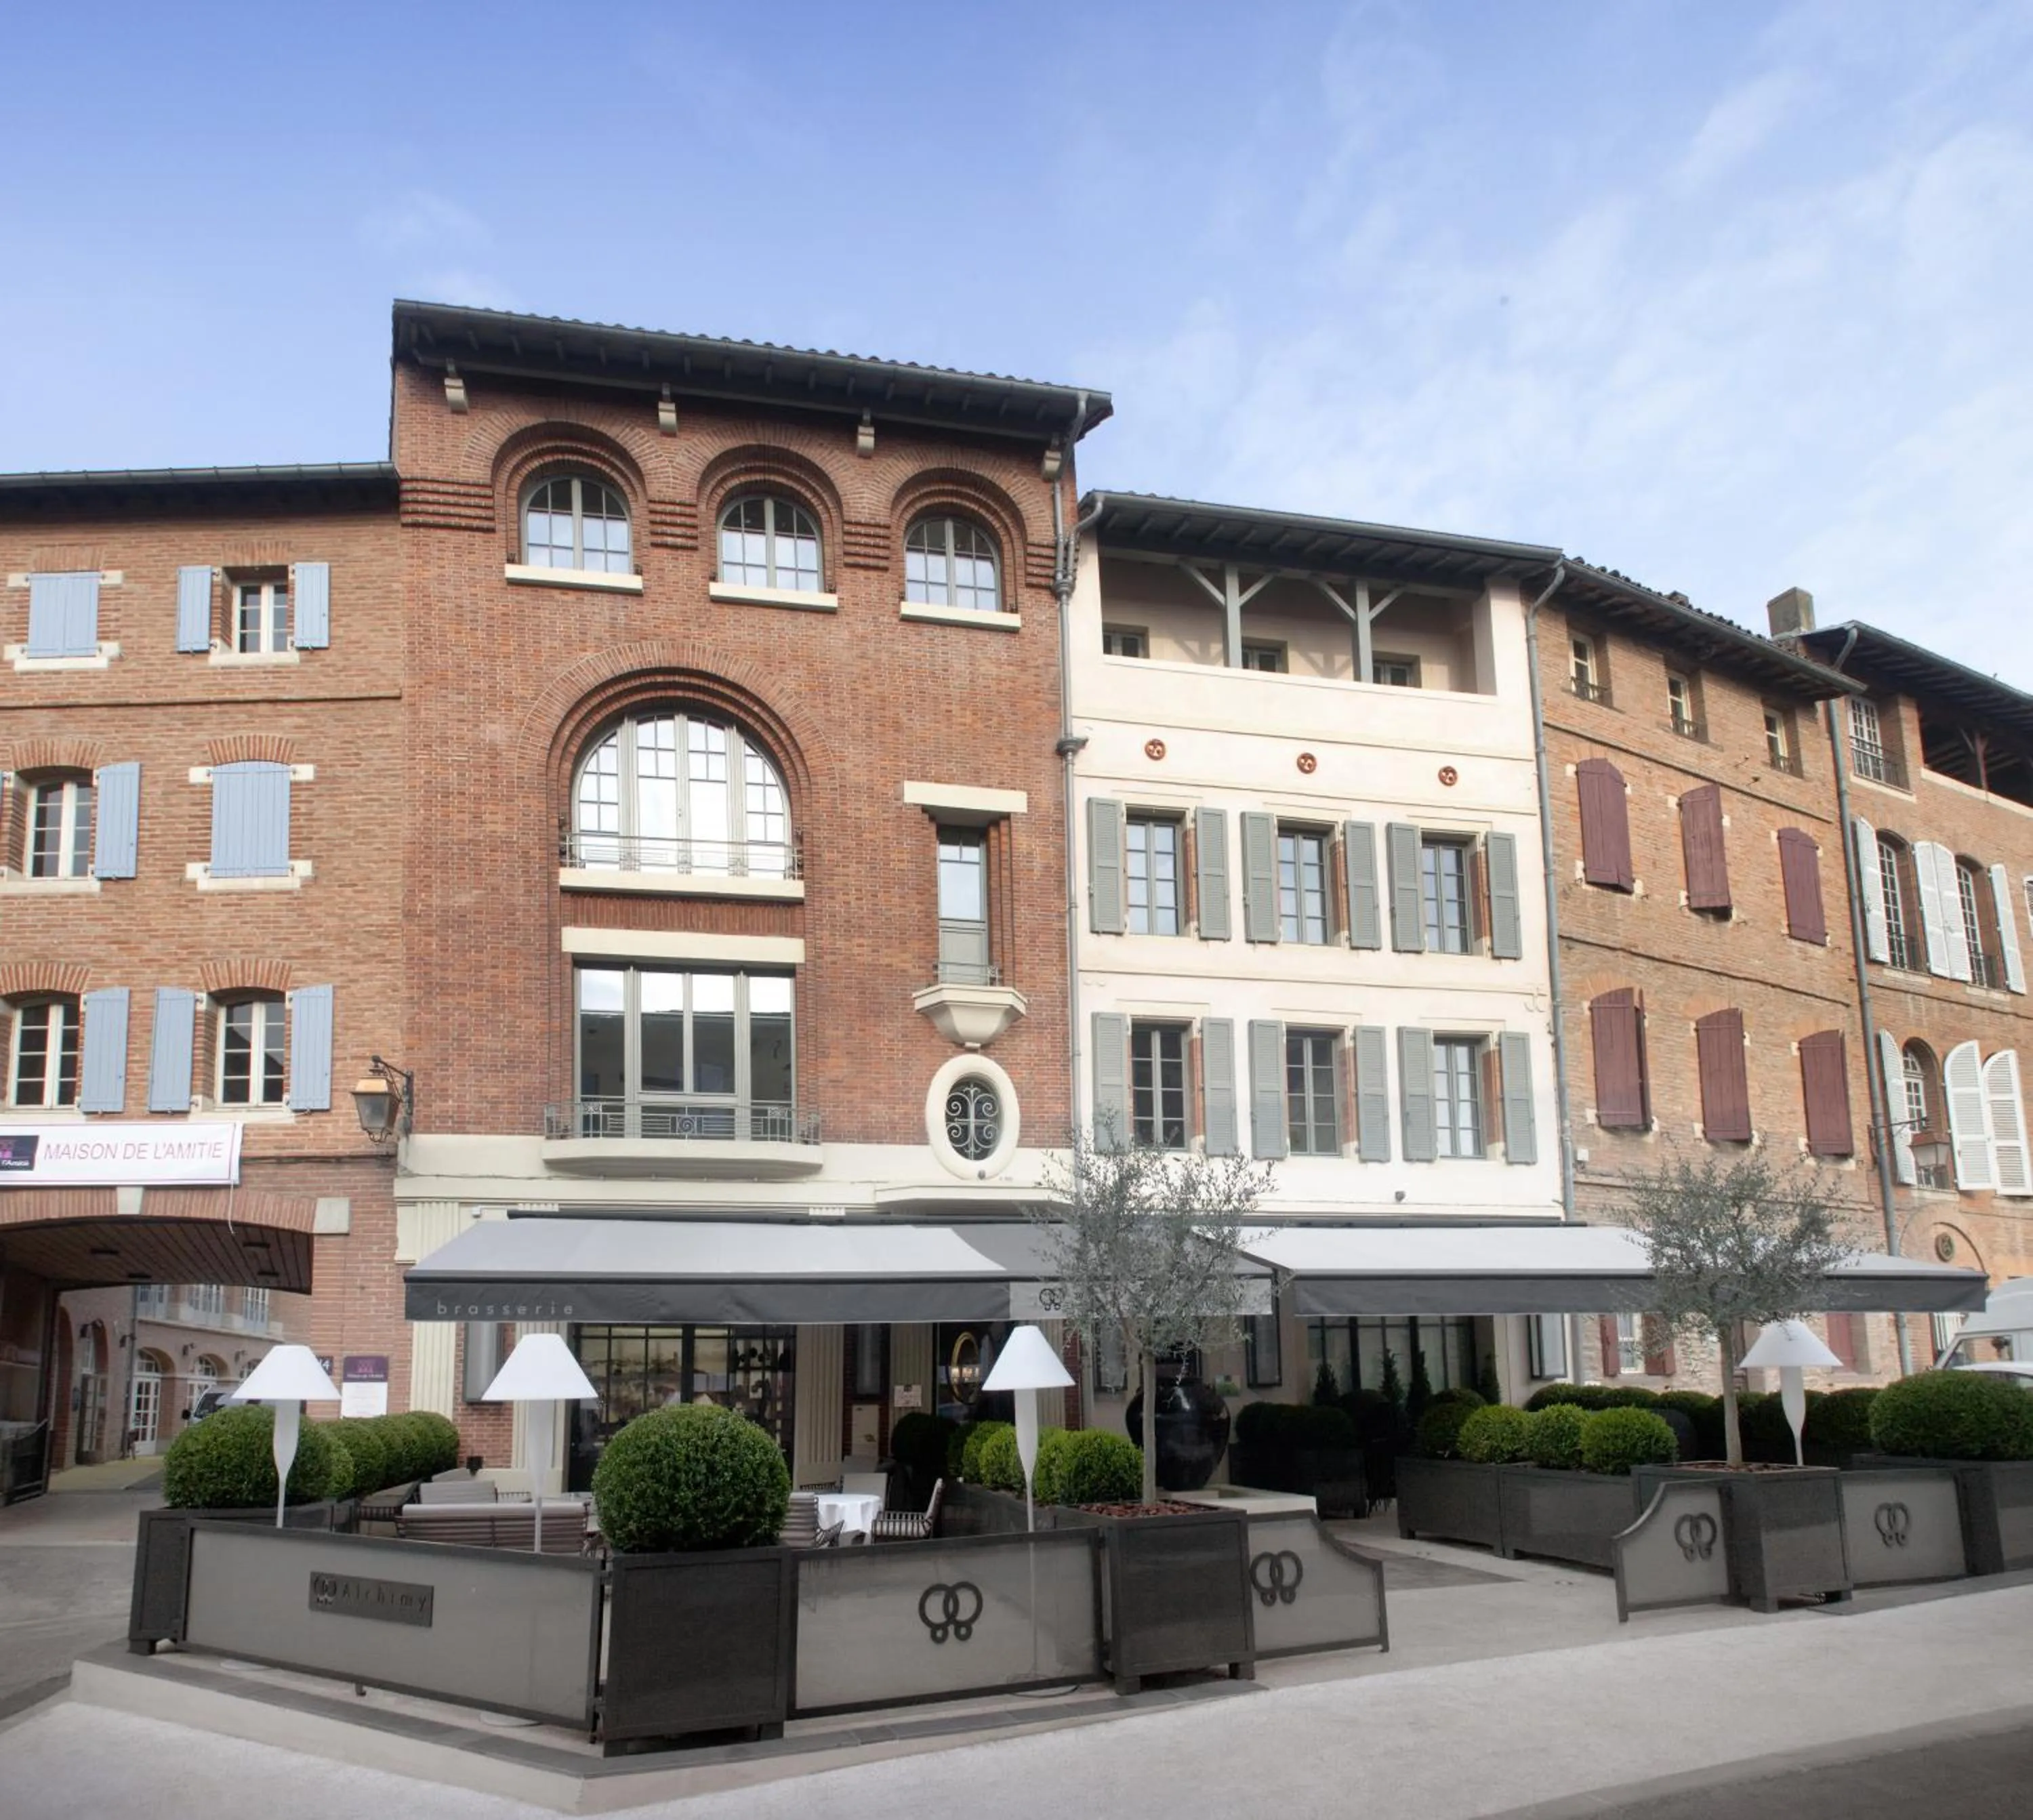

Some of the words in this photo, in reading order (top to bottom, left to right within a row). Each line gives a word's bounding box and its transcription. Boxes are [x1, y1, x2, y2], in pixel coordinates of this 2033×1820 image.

[44, 1143, 118, 1159] MAISON
[123, 1143, 148, 1159] DE
[153, 1142, 224, 1159] L'AMITIE
[437, 1300, 573, 1315] brasserie
[342, 1583, 427, 1613] Alchimy
